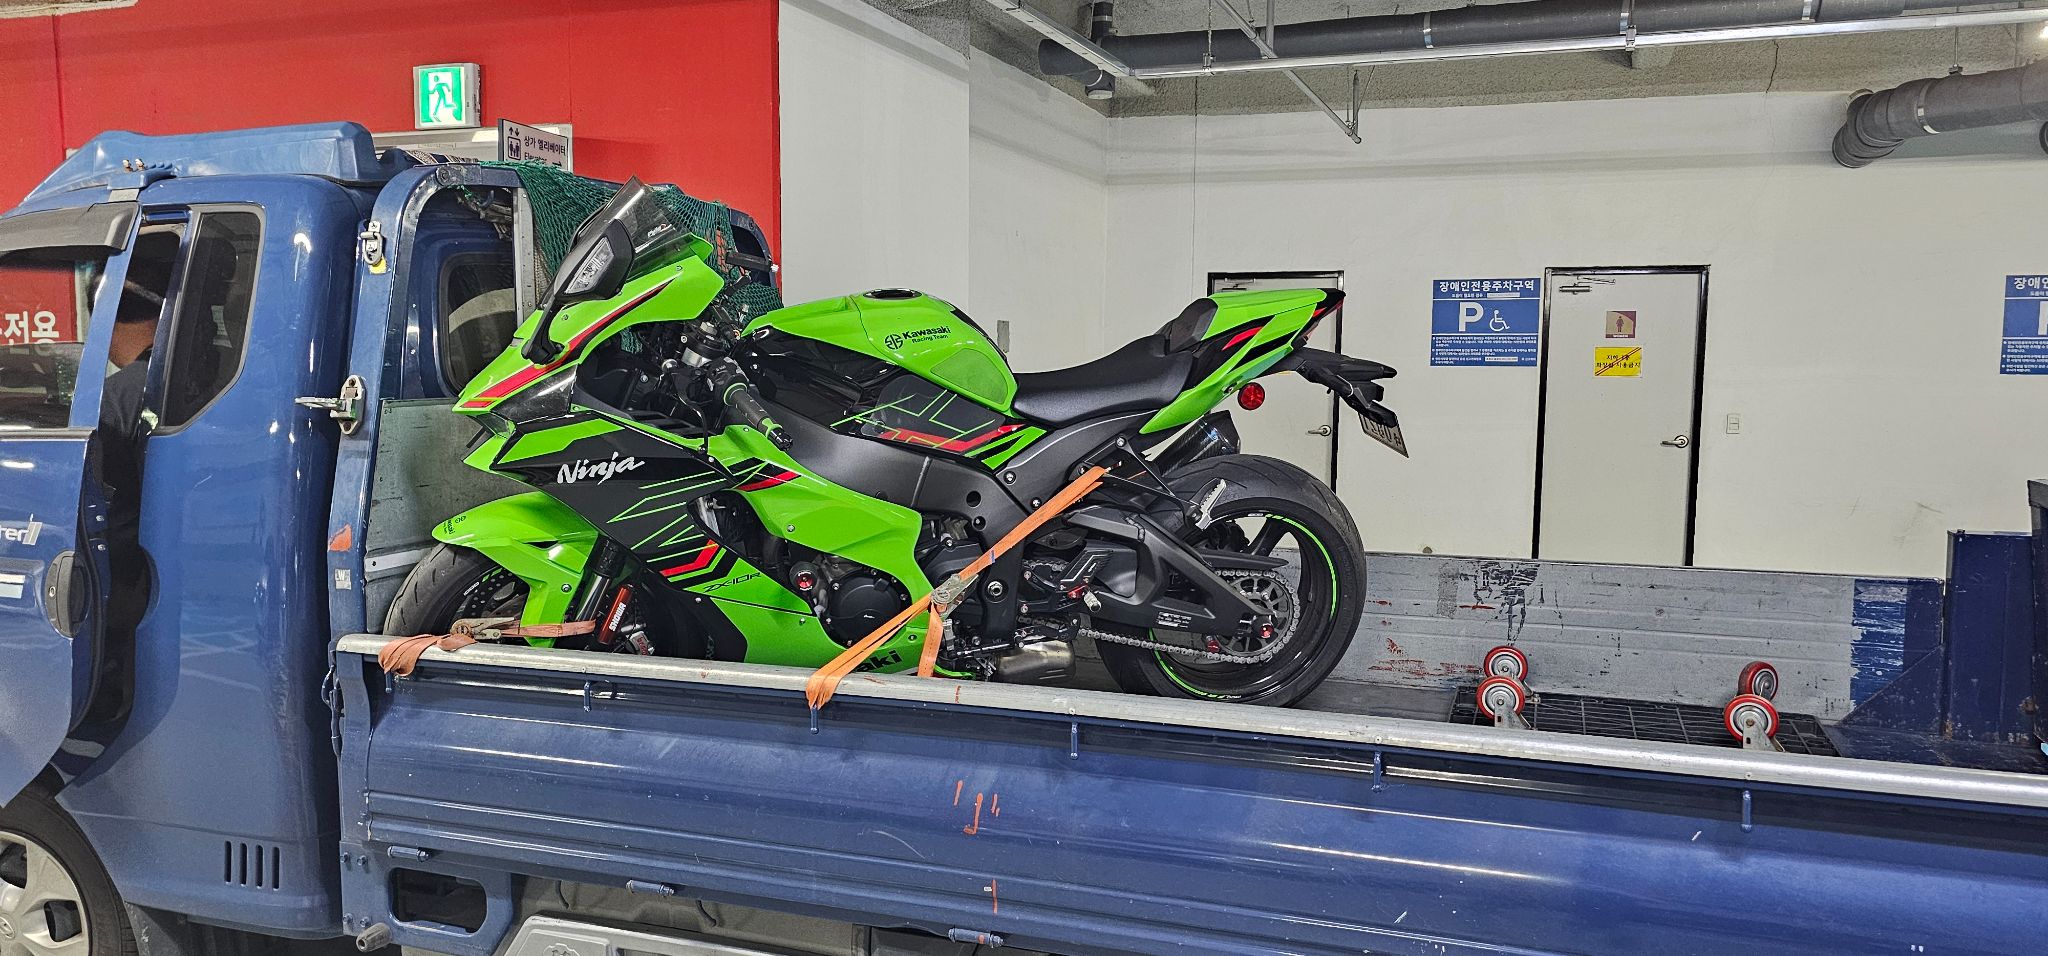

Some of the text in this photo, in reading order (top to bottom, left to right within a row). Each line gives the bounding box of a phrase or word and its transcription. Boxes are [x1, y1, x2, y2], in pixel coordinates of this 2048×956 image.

[524, 136, 566, 156] 상가 엘리베이터
[1439, 279, 1534, 292] 장애인전용주차구역
[1458, 301, 1484, 332] P
[0, 310, 60, 354] 전용
[902, 326, 951, 340] Kawasaki
[911, 335, 933, 344] Racing
[556, 451, 646, 486] Ninja
